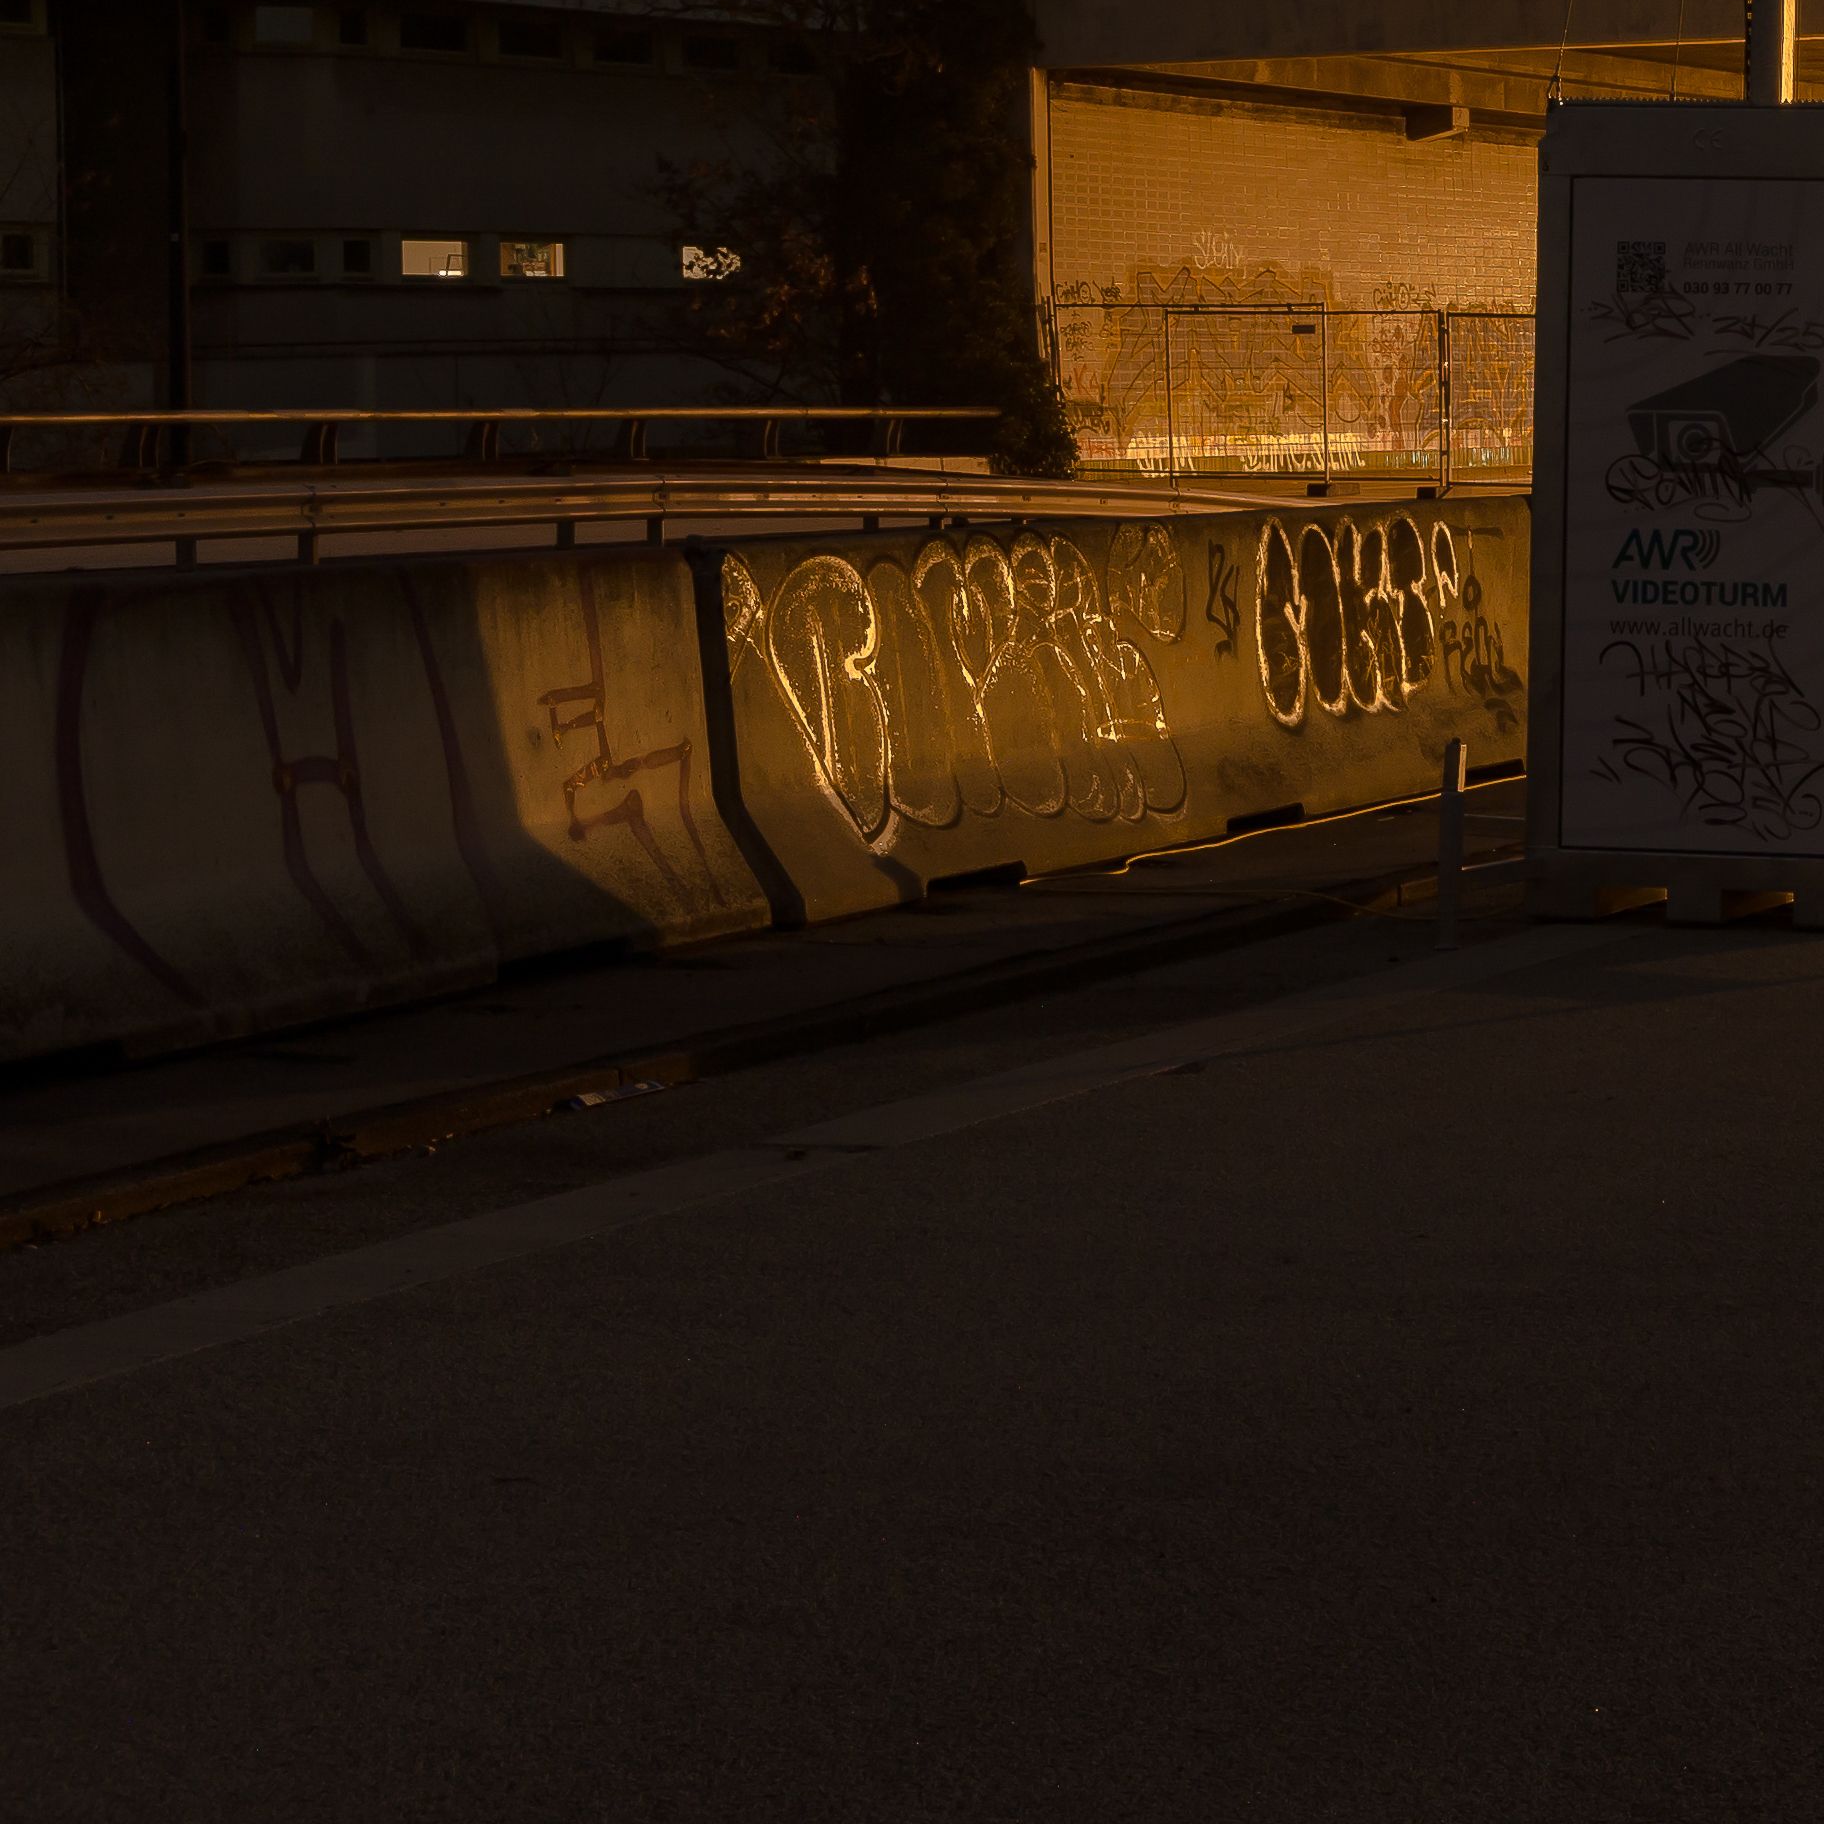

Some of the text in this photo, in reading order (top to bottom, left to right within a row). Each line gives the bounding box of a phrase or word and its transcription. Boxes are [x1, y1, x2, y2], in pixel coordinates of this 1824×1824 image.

[1684, 241, 1720, 257] AWR
[1724, 242, 1742, 257] All
[1682, 281, 1794, 296] 030 93 77 00 77
[1612, 528, 1699, 571] AWR
[1611, 579, 1789, 608] VIDEOTURM
[1610, 617, 1789, 639] www.allwacht.de
